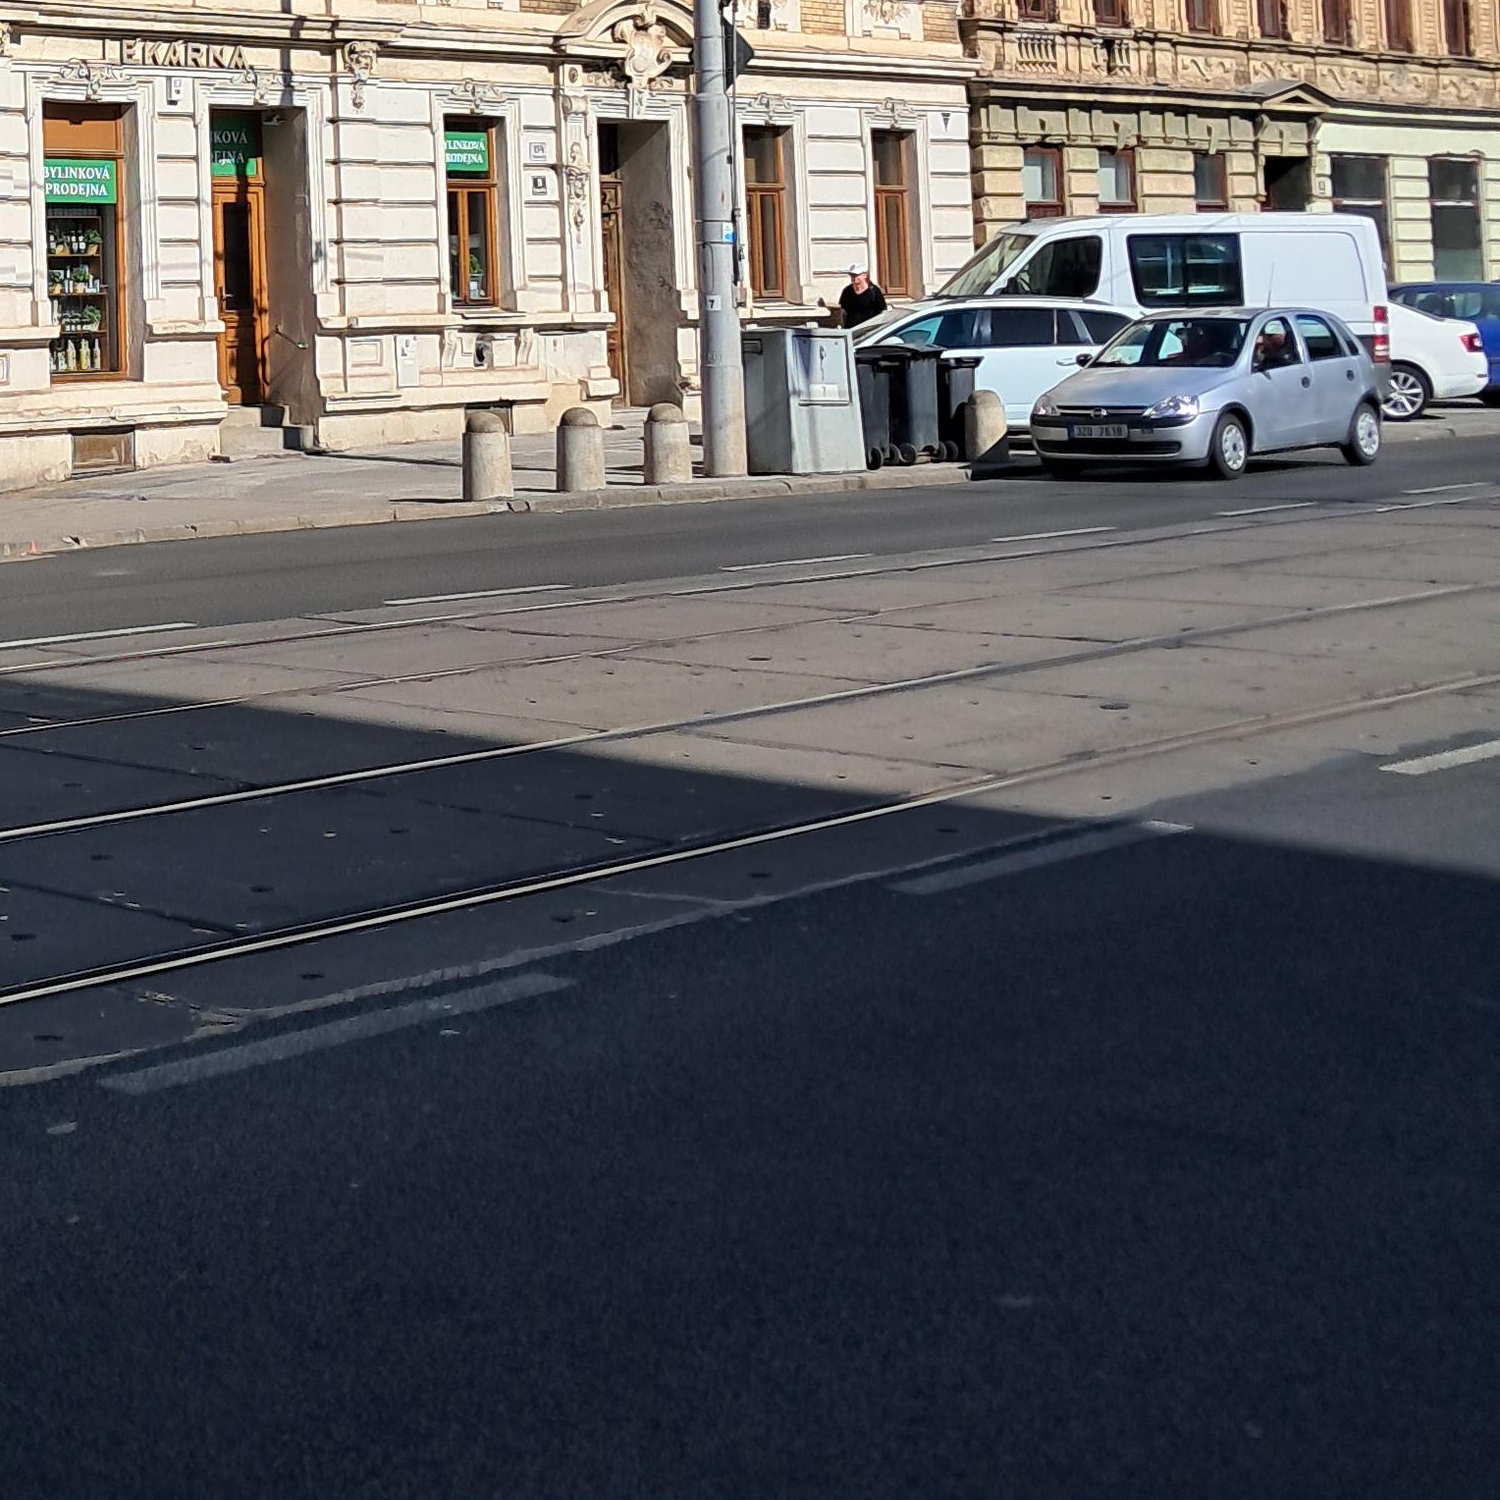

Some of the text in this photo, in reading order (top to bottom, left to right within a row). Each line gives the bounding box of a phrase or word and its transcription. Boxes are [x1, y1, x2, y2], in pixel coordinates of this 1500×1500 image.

[211, 128, 247, 144] KOVÁ
[43, 164, 110, 179] BYLINKOVÁ
[45, 183, 108, 197] PRODEJNA
[708, 299, 715, 309] 7
